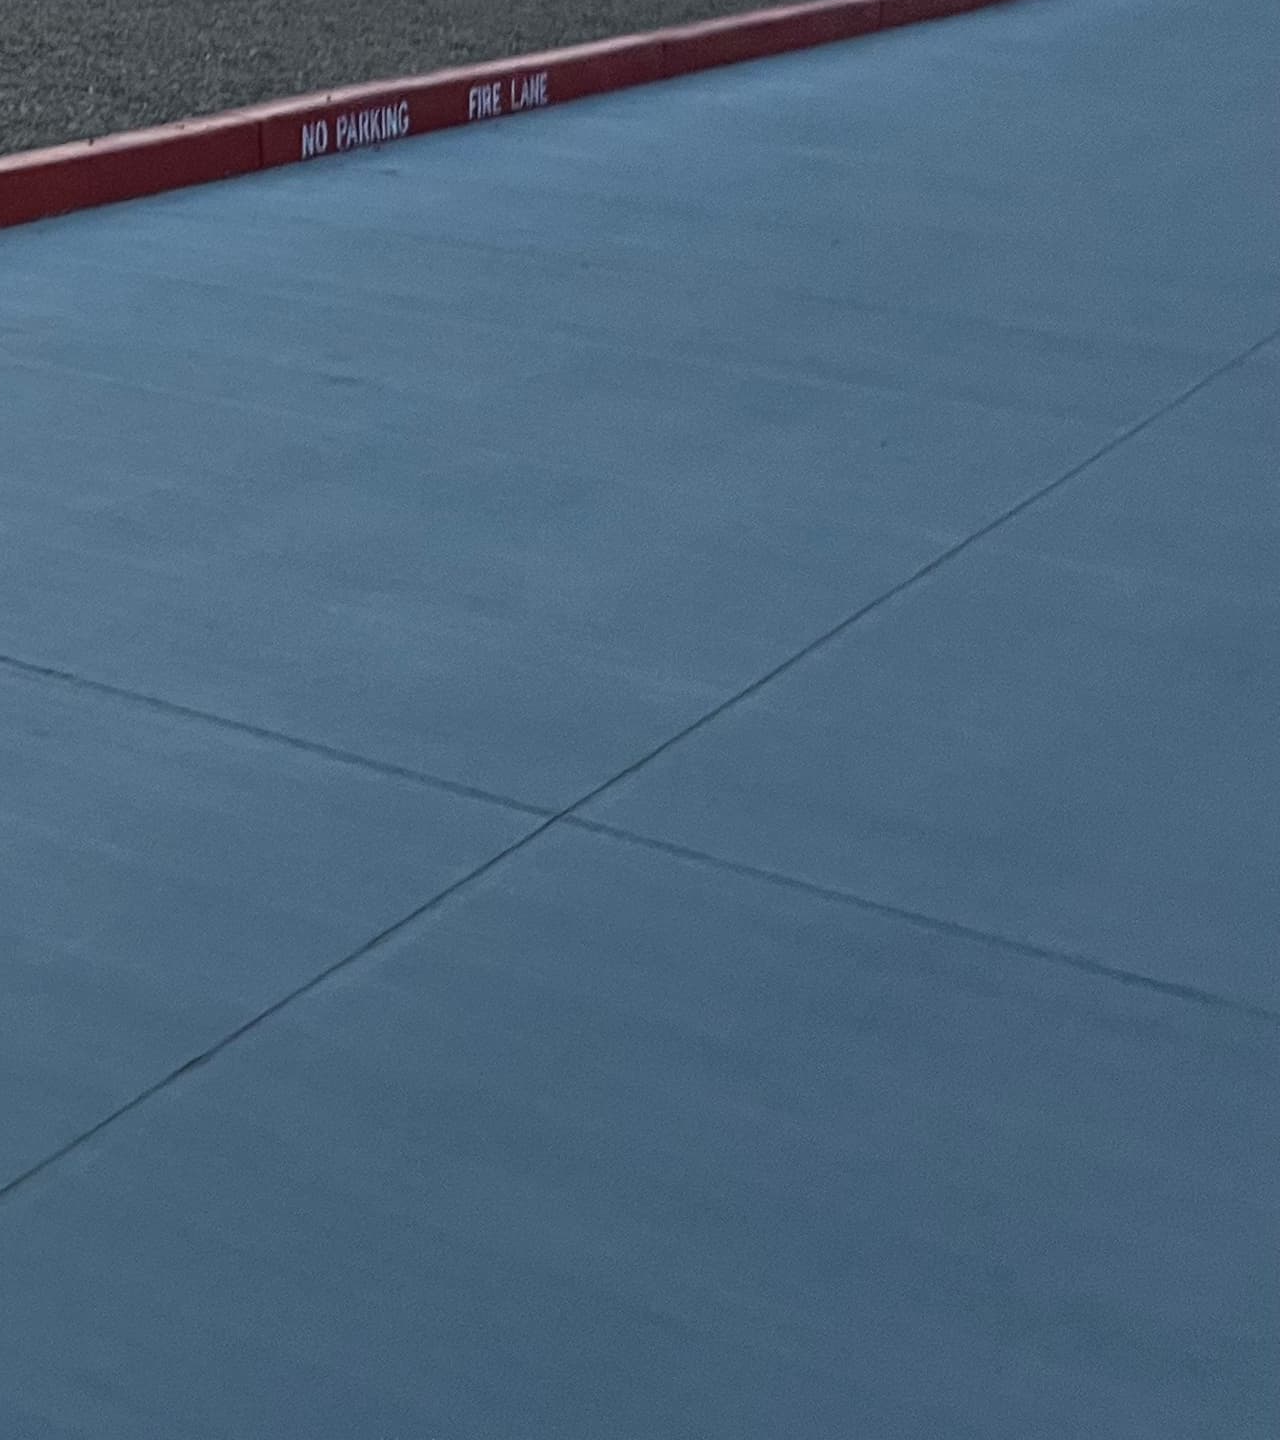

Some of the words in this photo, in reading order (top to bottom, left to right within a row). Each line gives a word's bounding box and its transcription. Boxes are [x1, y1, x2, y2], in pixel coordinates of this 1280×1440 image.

[469, 82, 502, 120] FIRE
[511, 71, 548, 109] LANE
[301, 120, 328, 158] NO
[336, 100, 409, 148] PARKING
